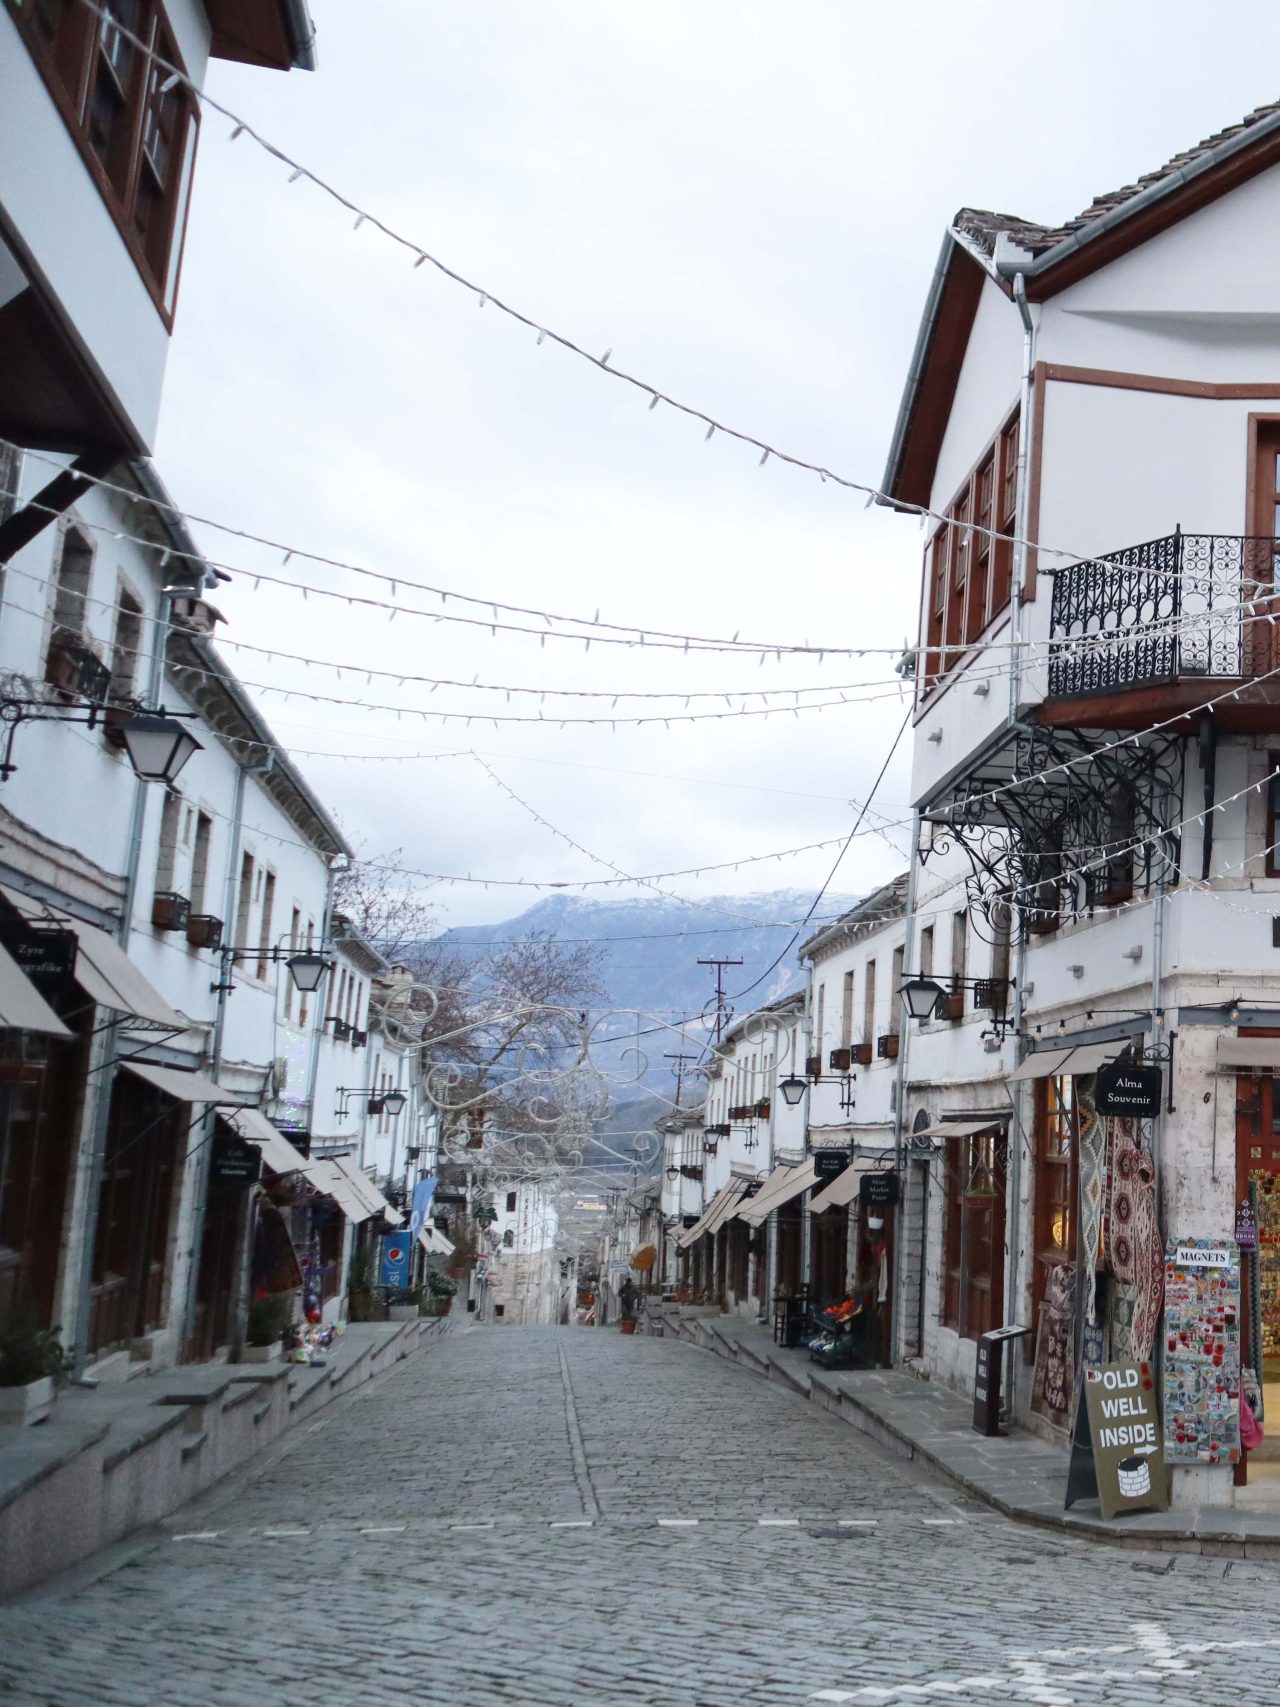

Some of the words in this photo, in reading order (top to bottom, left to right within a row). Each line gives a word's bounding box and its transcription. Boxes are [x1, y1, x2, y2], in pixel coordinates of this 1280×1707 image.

[1115, 1077, 1143, 1089] Alma
[1107, 1092, 1152, 1105] Souvenir
[1180, 1252, 1226, 1263] MAGNETS
[979, 1348, 987, 1361] OLD
[978, 1364, 987, 1378] WELL
[1103, 1368, 1139, 1390] OLD
[1100, 1395, 1148, 1418] WELL
[1099, 1422, 1156, 1448] INSIDE
